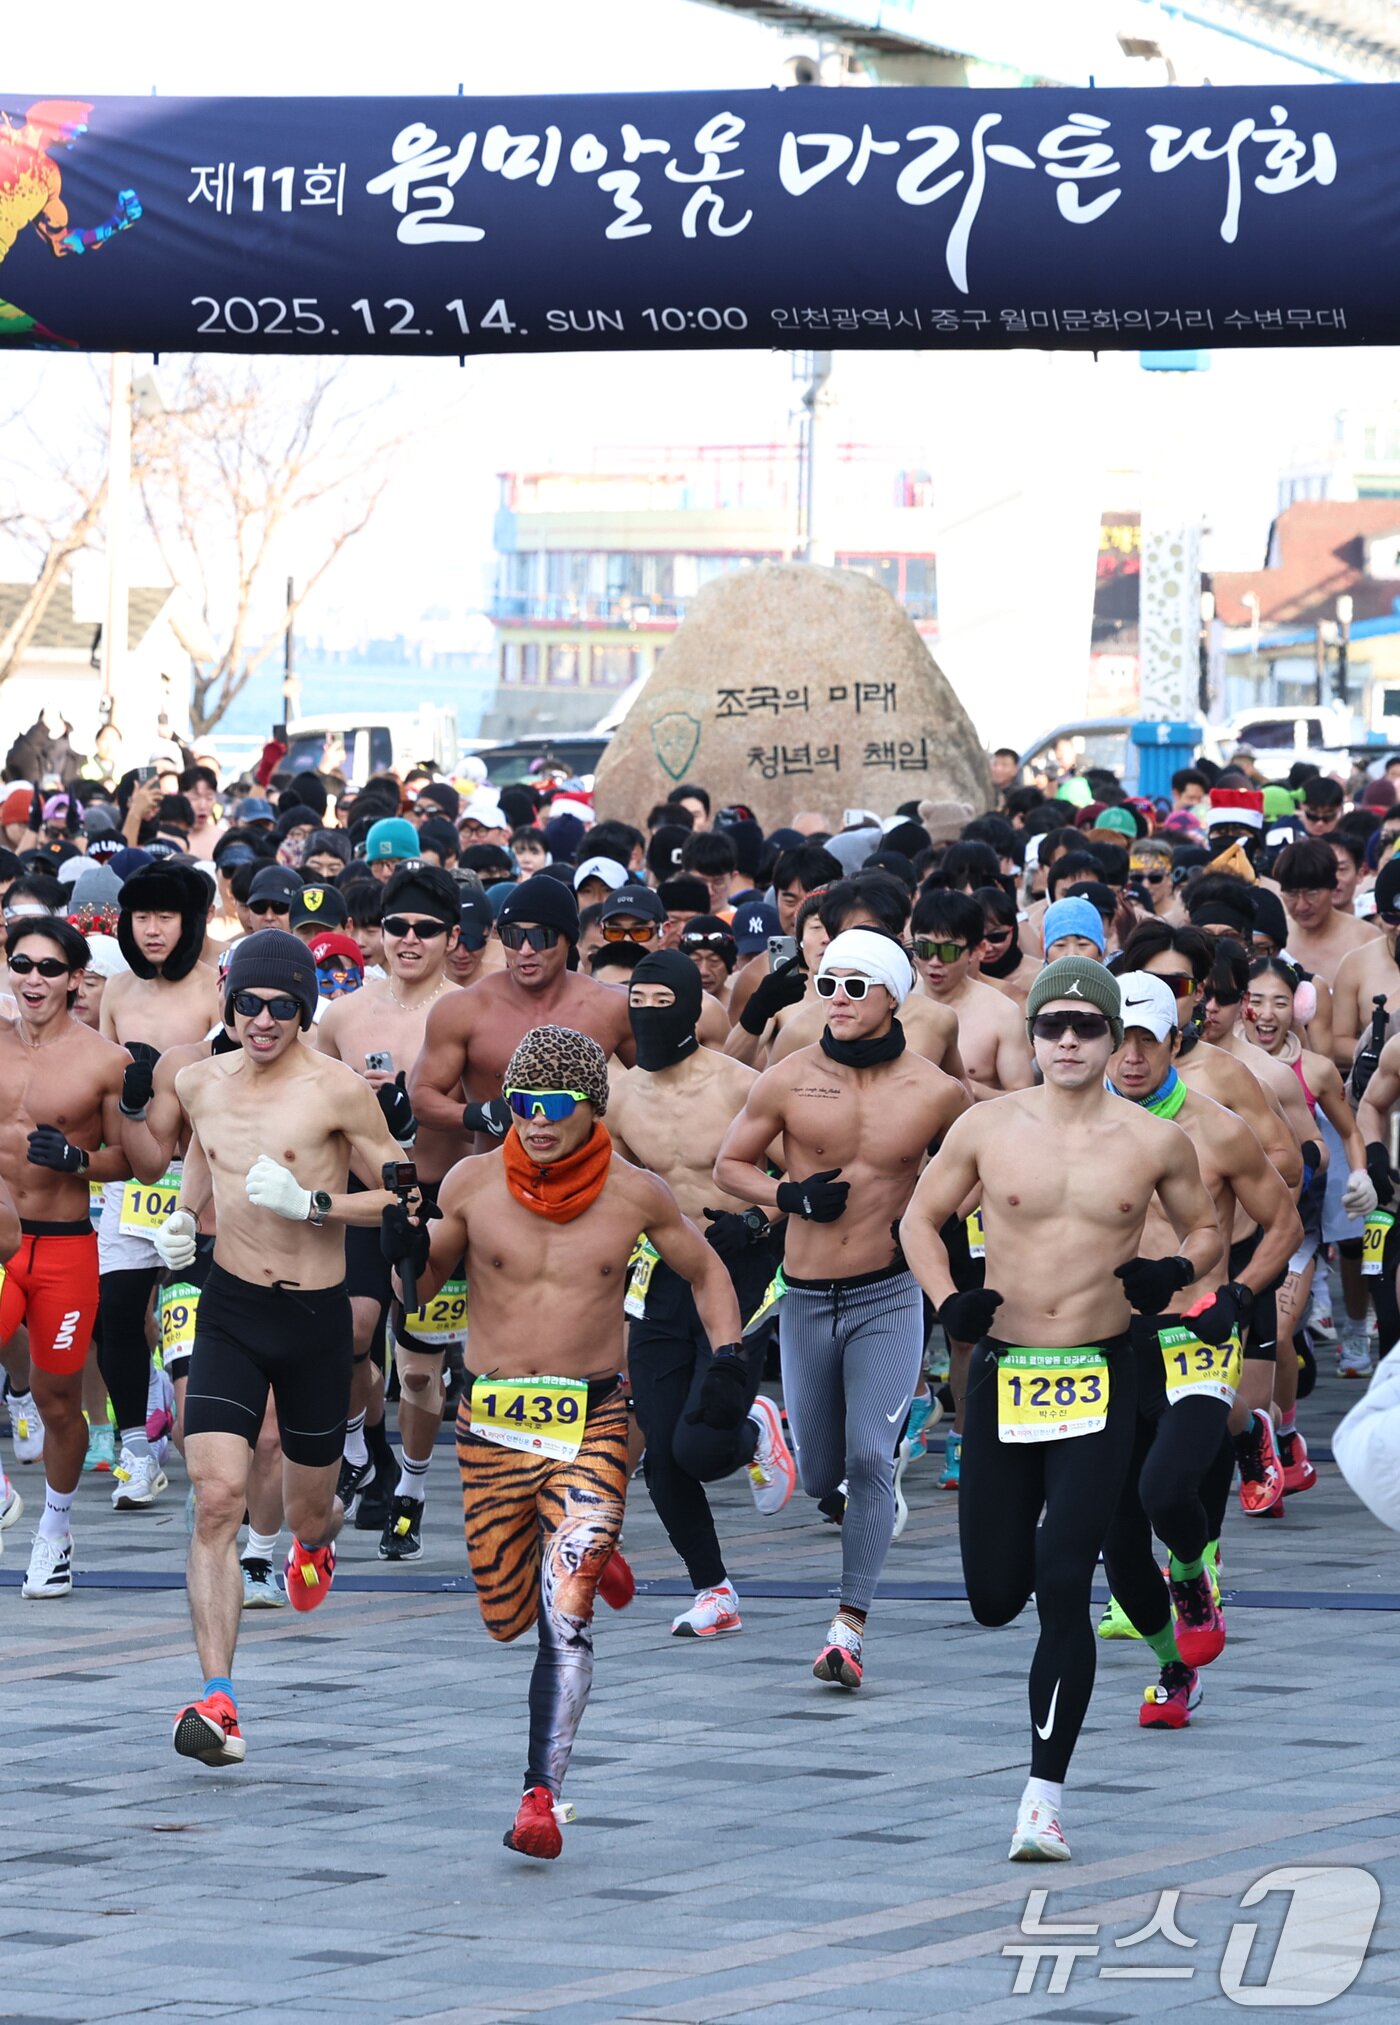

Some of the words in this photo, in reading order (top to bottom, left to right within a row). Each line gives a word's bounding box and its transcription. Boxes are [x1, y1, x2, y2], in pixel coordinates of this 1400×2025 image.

[187, 162, 347, 216] 제11회
[365, 111, 753, 245] 월미알몸
[191, 296, 339, 335] 2025.
[351, 298, 434, 335] 12.
[445, 298, 528, 335] 14.
[546, 309, 624, 332] SUN
[641, 307, 748, 331] 10:00
[770, 307, 922, 331] 인천광역시
[931, 308, 991, 331] 중구
[1000, 308, 1213, 332] 월미문화의거리
[1223, 308, 1348, 330] 수변무대
[716, 686, 809, 719] 조국의
[829, 682, 897, 713] 미래
[748, 744, 841, 780] 청년의
[864, 738, 929, 771] 책임
[482, 1394, 579, 1424] 1439
[1008, 1375, 1102, 1407] 1283
